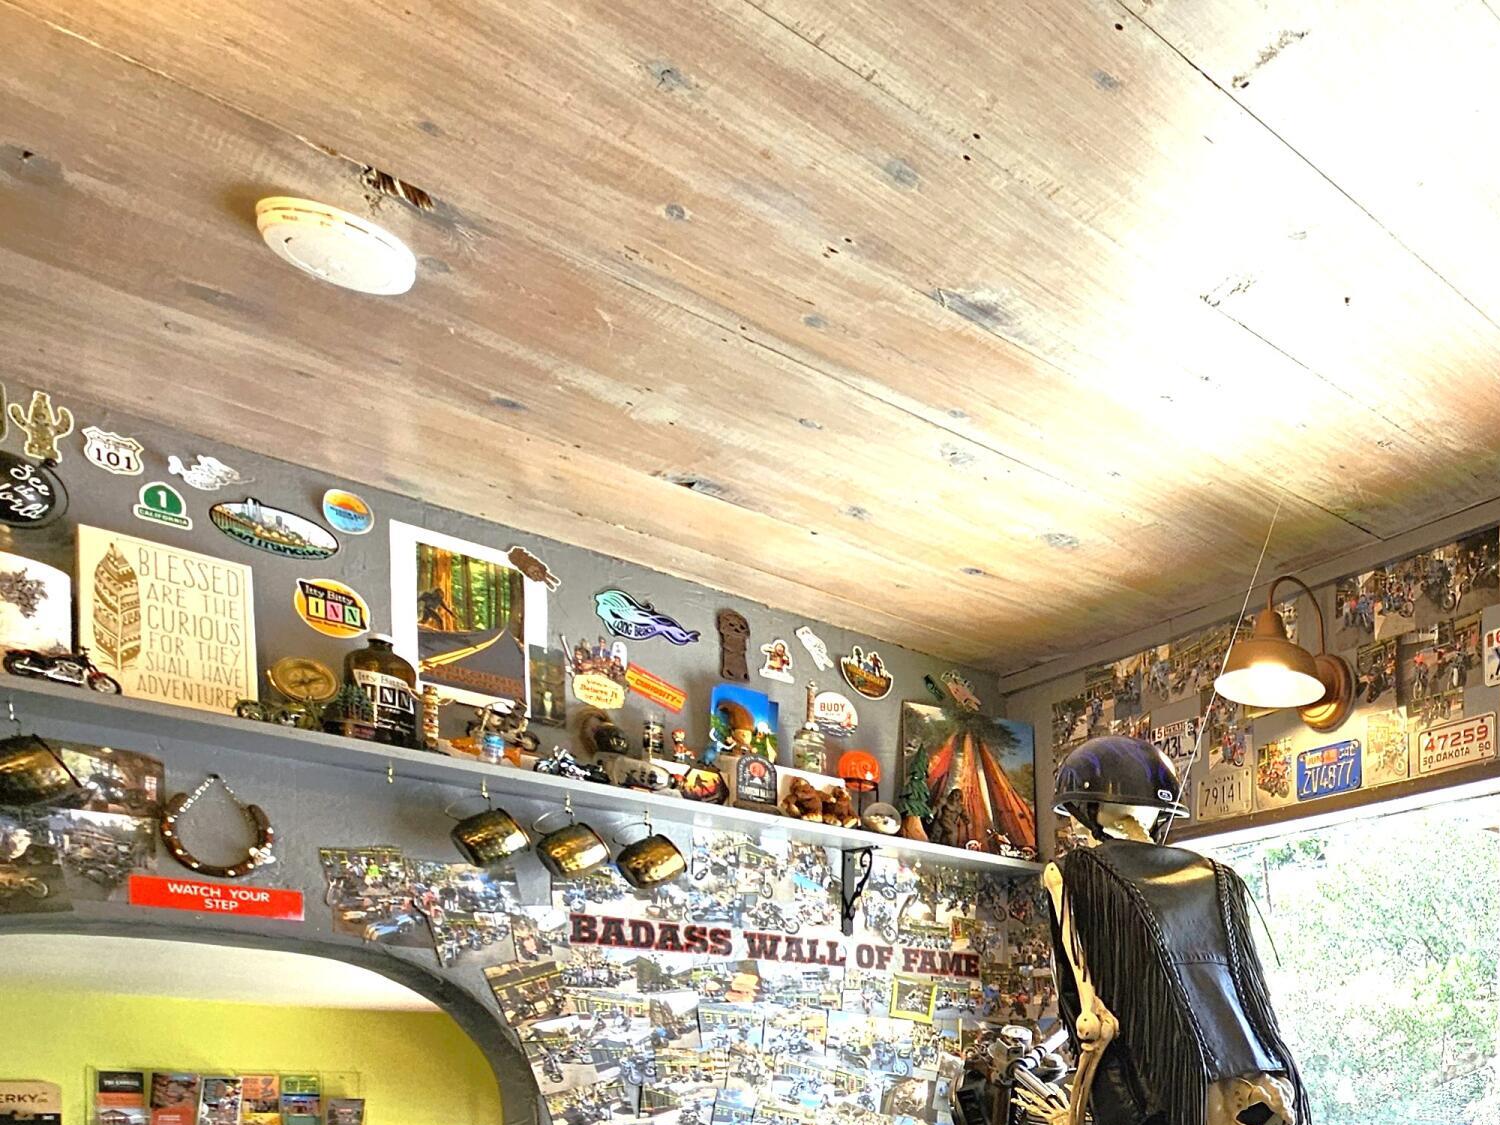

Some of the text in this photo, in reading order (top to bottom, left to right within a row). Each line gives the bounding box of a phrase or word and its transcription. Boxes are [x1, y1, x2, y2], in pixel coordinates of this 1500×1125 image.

[96, 448, 133, 470] 101
[10, 464, 50, 496] See
[158, 490, 168, 508] 1
[138, 507, 188, 527] CALIFORNIA
[138, 547, 240, 598] BLESSED
[146, 583, 239, 621] ARE THE
[305, 584, 354, 606] Itty Bitty
[314, 601, 357, 623] INN
[147, 604, 241, 647] CURIOUS
[612, 619, 633, 636] LONG
[149, 631, 241, 666] FOR THEY
[145, 650, 244, 689] SHALL HAVE
[136, 675, 244, 710] ADVENTURES
[634, 679, 678, 702] CURIOSITY
[819, 702, 846, 713] BUOY
[1156, 728, 1165, 740] 5
[1424, 723, 1489, 752] 47259
[1204, 781, 1242, 808] 79141
[167, 882, 271, 903] WATCH YOUR
[204, 898, 239, 911] STEP
[569, 912, 981, 978] BADASS WALL OF FAME
